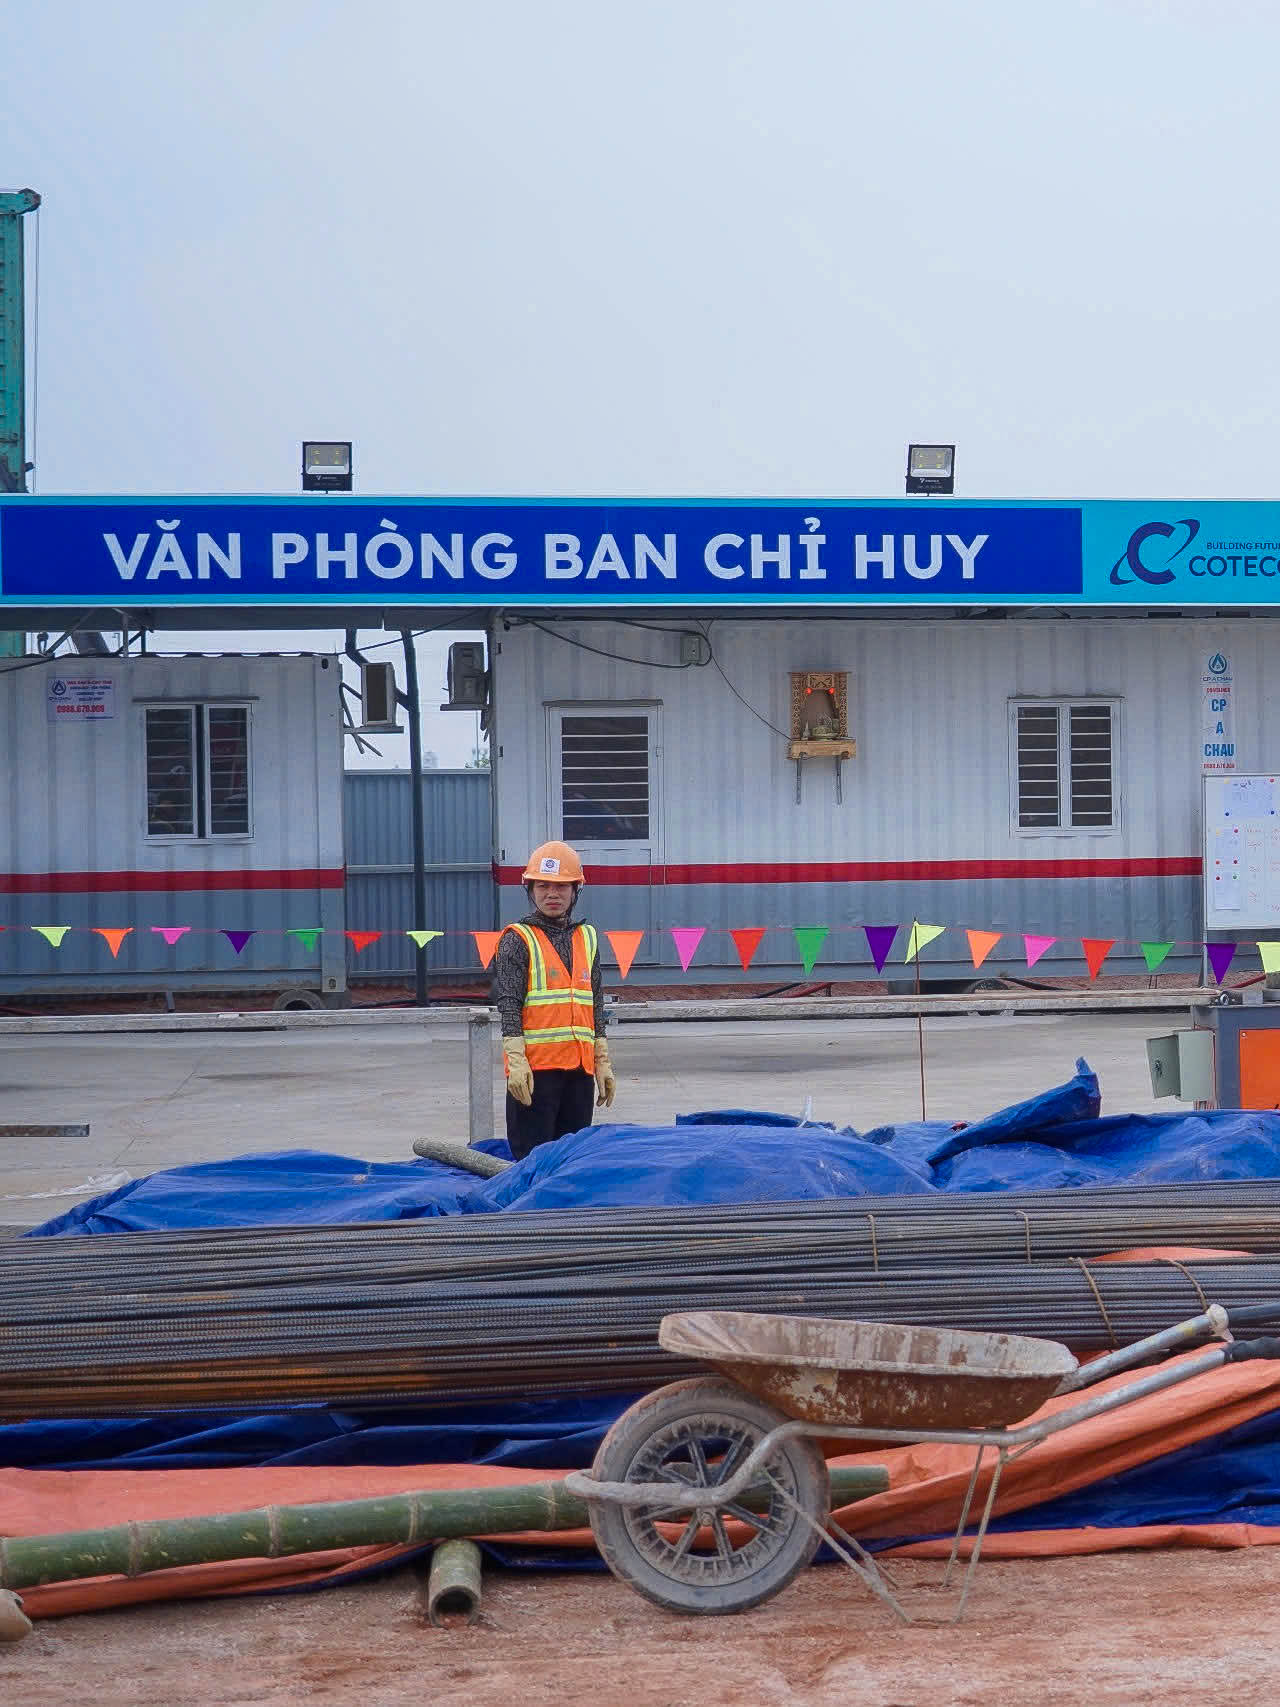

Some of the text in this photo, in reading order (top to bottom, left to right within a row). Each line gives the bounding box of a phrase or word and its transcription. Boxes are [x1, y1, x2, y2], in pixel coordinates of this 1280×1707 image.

[103, 516, 990, 580] VĂN PHÒNG BAN CHỈ HUY
[1206, 541, 1253, 551] BUILDING
[1211, 699, 1227, 712] CP
[1216, 721, 1224, 734] A
[1204, 743, 1235, 757] CHAU
